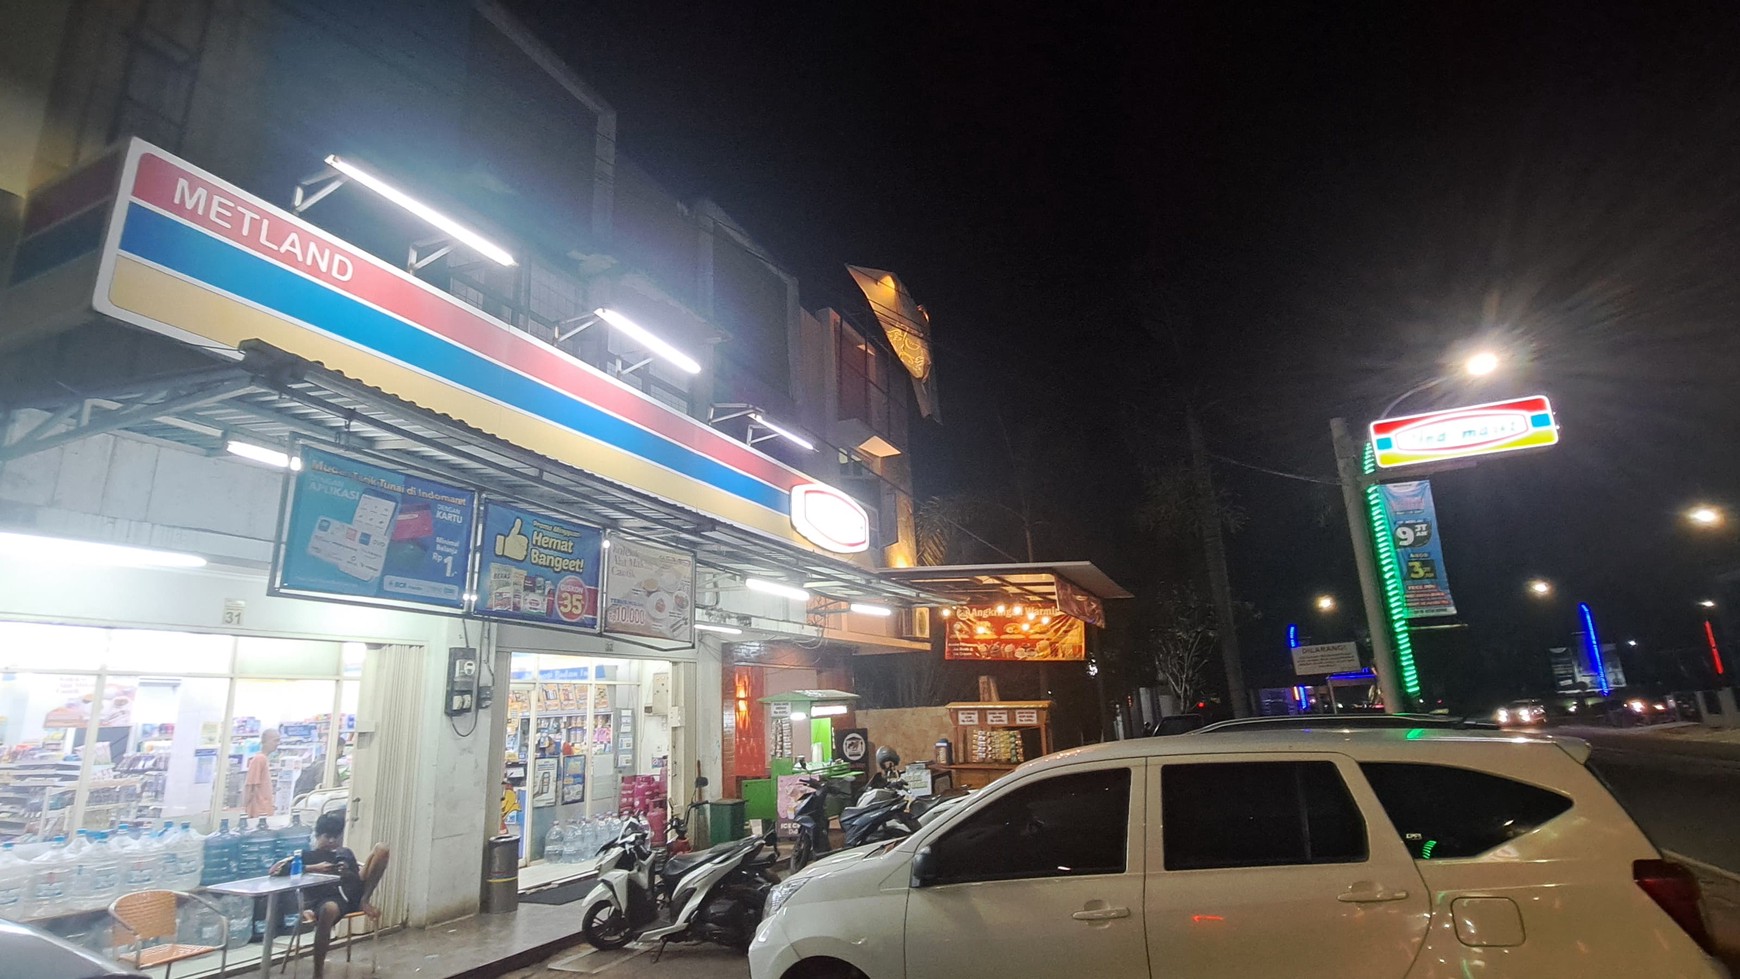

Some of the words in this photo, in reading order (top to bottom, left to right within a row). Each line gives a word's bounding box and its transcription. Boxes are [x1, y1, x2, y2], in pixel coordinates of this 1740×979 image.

[173, 176, 354, 283] METLAND
[308, 481, 361, 501] APLIKASI
[379, 478, 405, 494] Tunai
[406, 486, 417, 496] di
[435, 510, 463, 524] KARTU
[532, 530, 575, 554] Hemat
[1395, 526, 1415, 546] 9
[431, 552, 443, 564] Rp
[530, 548, 585, 573] Bangeet!
[1408, 560, 1425, 579] 3
[559, 591, 583, 615] 35
[971, 606, 1023, 619] Angkrngn
[224, 611, 242, 625] 31
